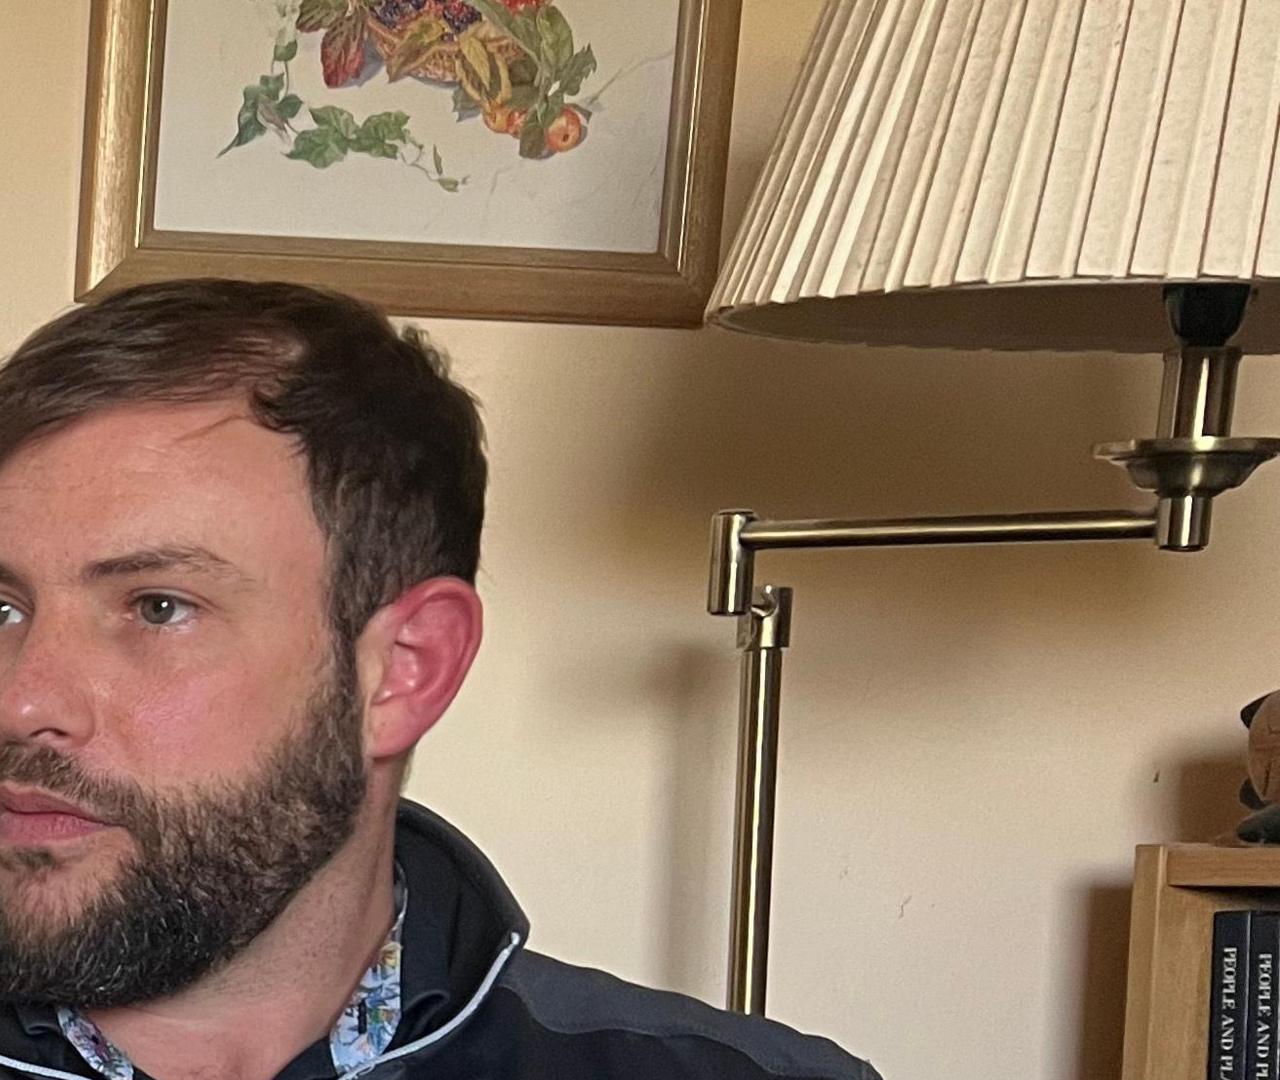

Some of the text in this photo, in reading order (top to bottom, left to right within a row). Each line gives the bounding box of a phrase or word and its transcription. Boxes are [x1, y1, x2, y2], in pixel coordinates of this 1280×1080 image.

[1221, 947, 1237, 1010] PEOPLE
[1256, 953, 1272, 1017] PEOPLE
[1220, 1014, 1235, 1050] AND
[1255, 1020, 1270, 1058] AND
